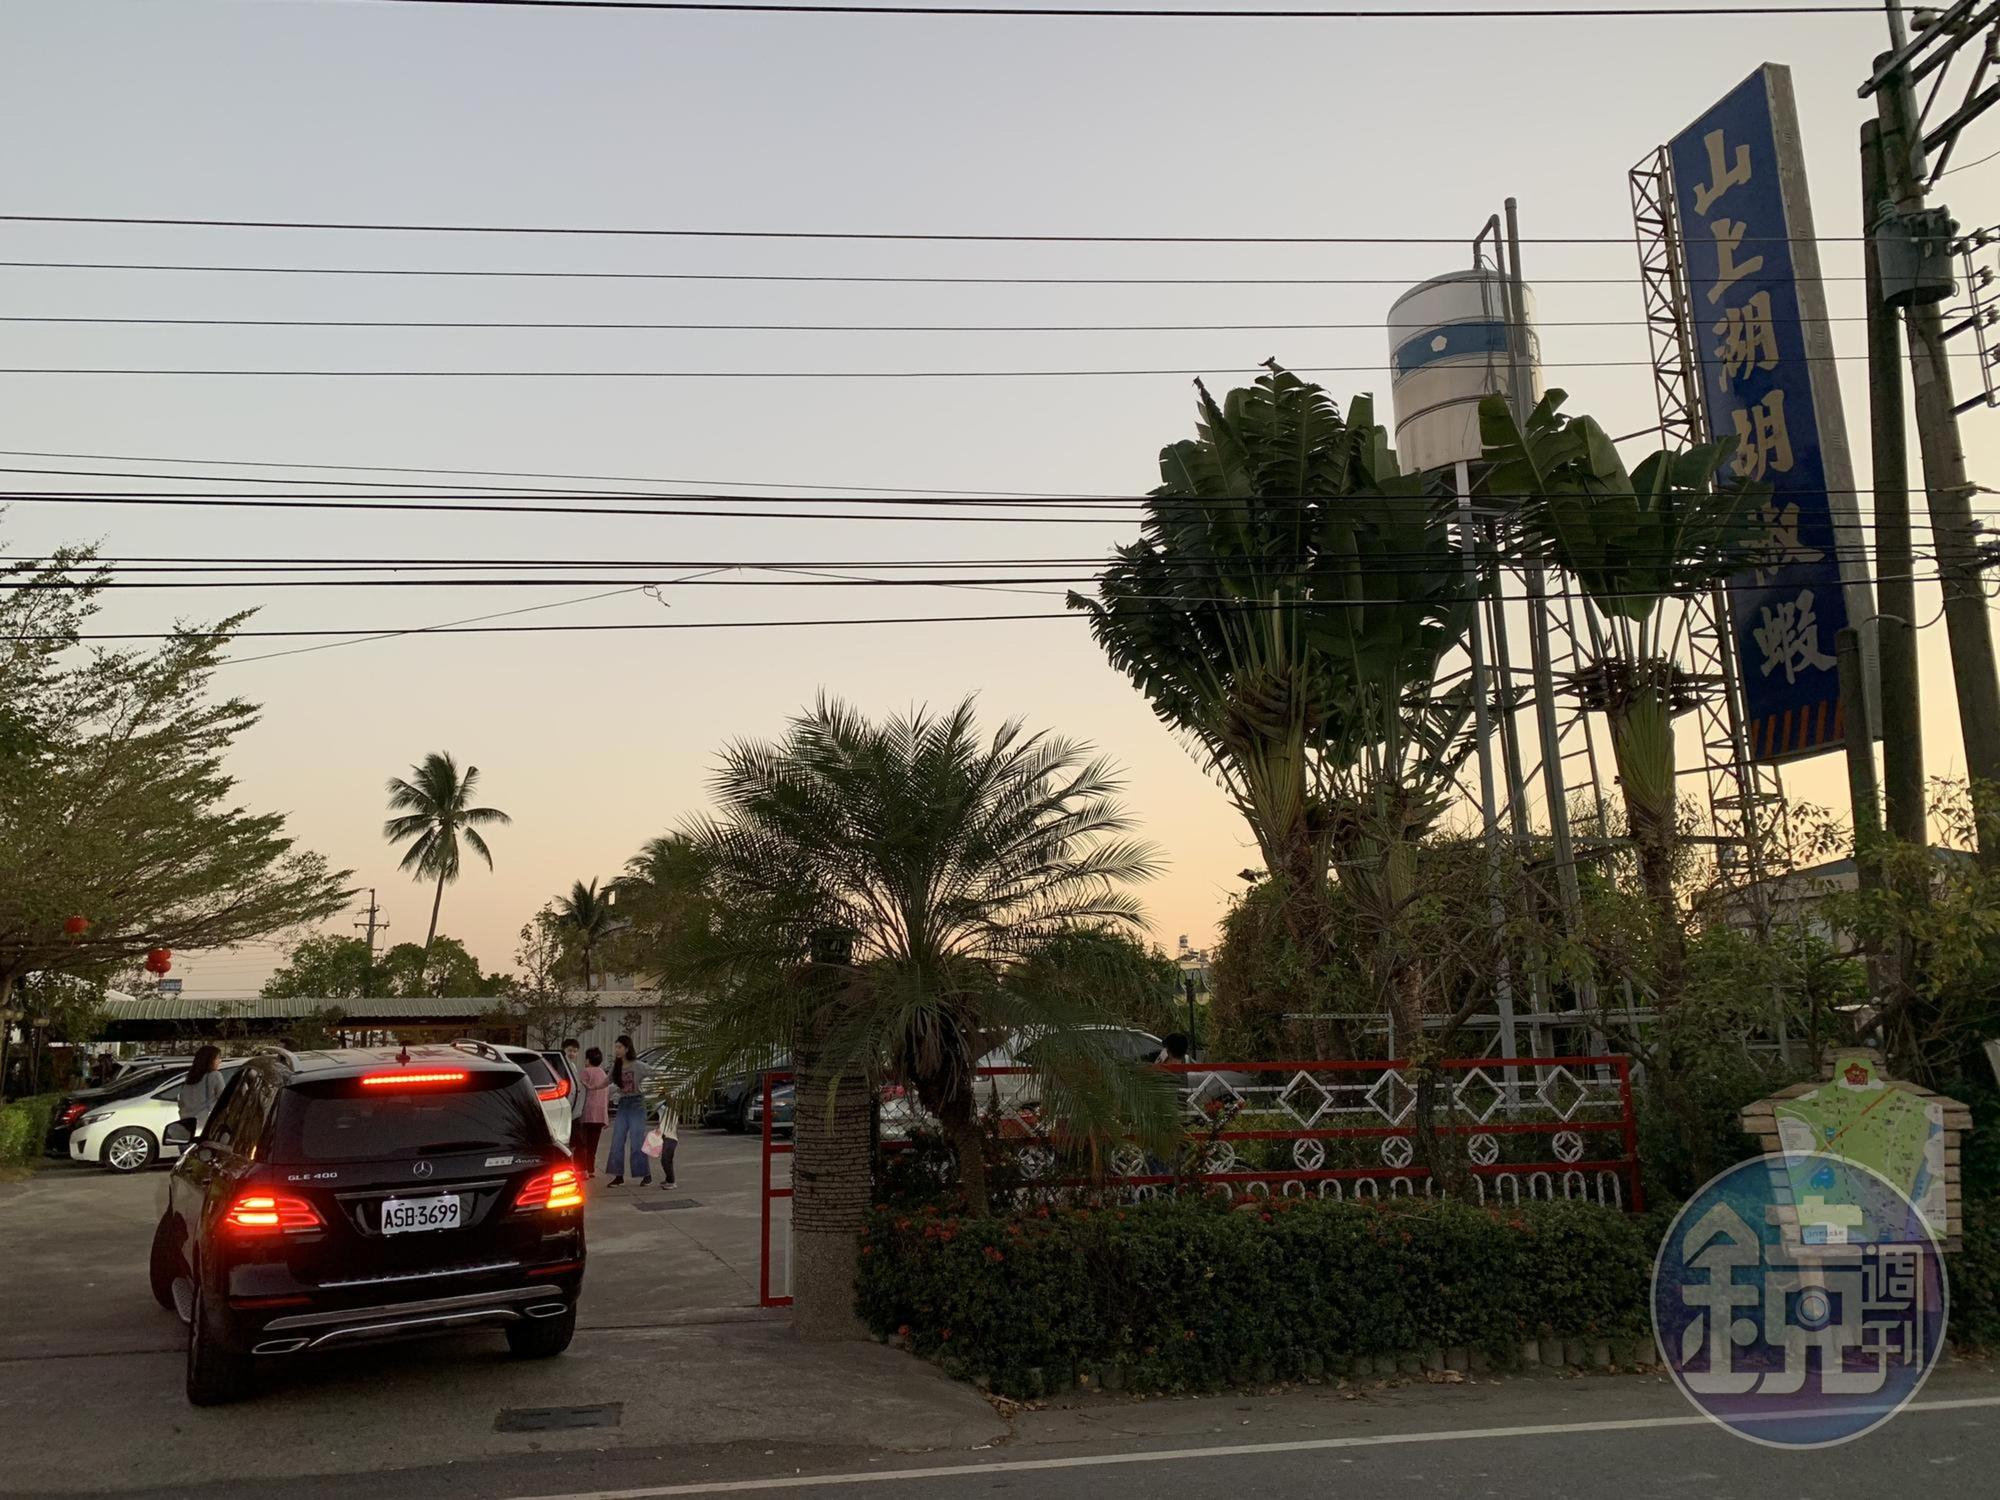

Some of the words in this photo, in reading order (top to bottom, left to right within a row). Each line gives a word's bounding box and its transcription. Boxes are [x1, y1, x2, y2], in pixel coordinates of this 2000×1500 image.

[1693, 128, 1838, 685] 山上湖胡椒蝦
